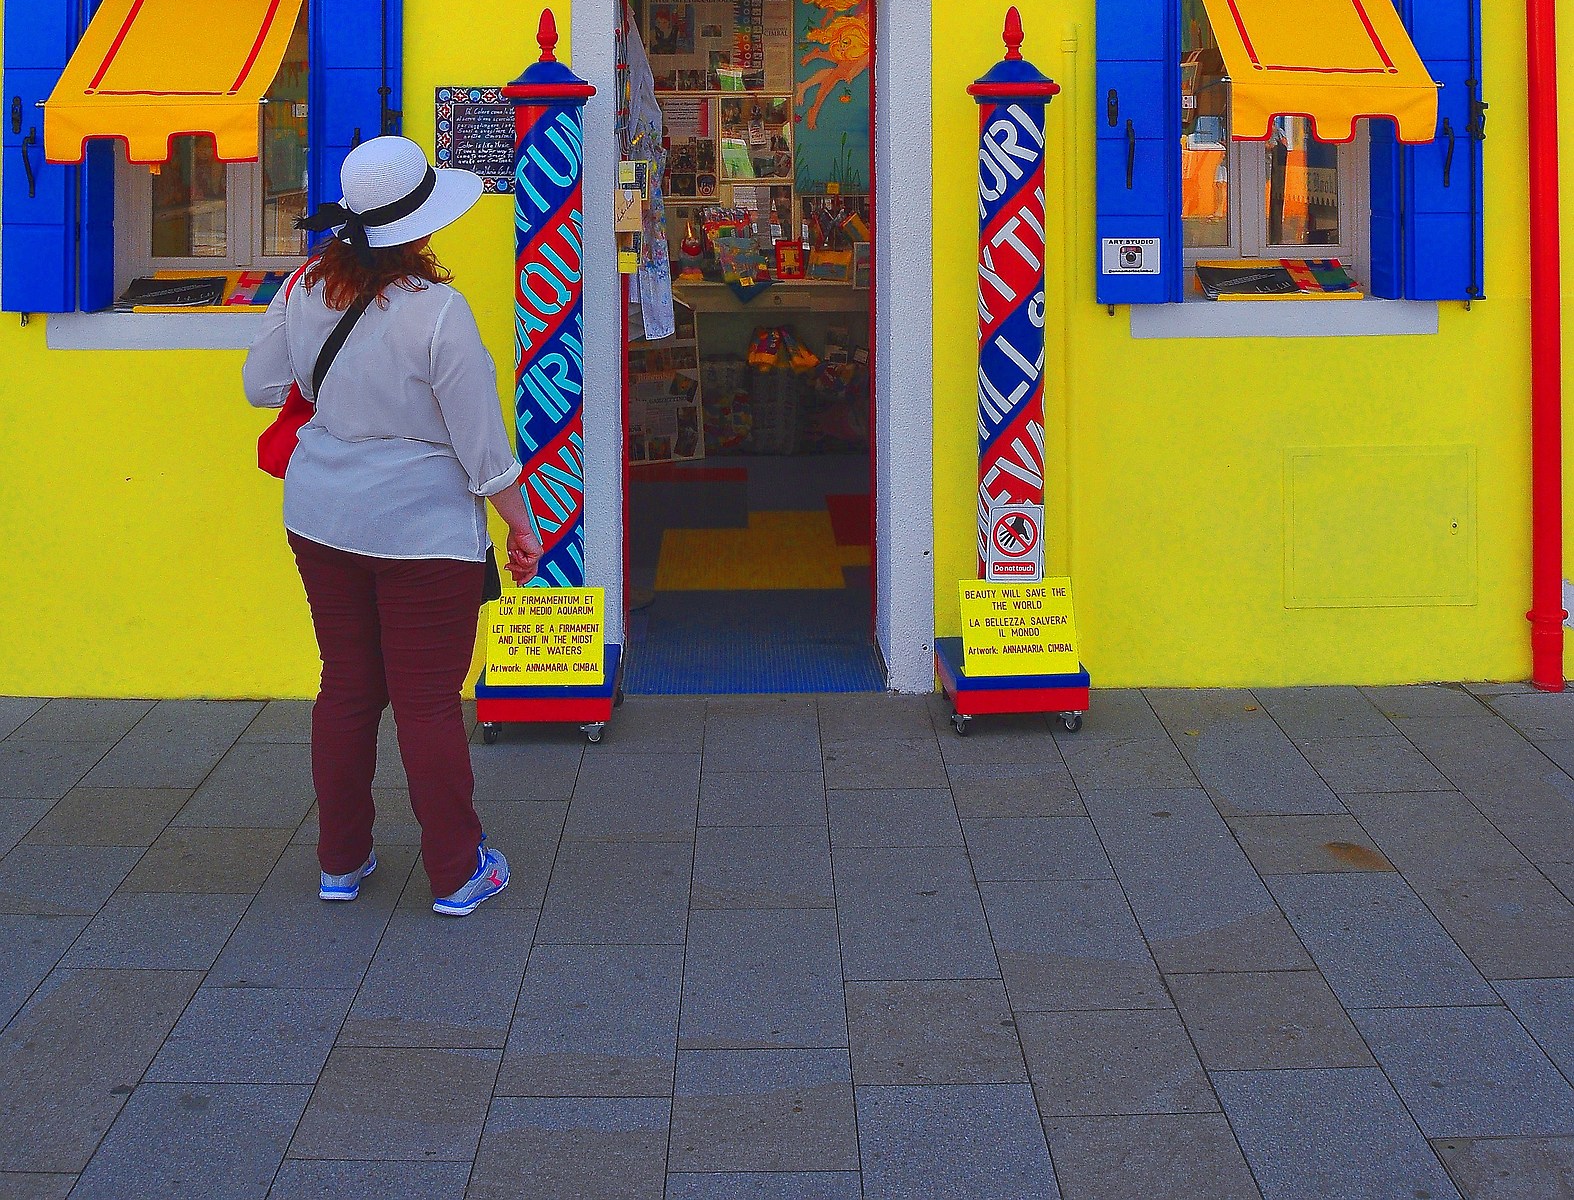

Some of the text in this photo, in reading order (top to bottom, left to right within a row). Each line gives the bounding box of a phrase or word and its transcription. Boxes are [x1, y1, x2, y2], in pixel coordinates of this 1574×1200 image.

[1016, 564, 1034, 572] touch
[965, 588, 1066, 599] BEAUTY WILL SAVE THE
[499, 596, 594, 605] FIAT FIRMAMENTUM ET
[992, 600, 1042, 610] THE WORLD
[499, 606, 594, 615] LUX IN MEDIO AQUARUM
[969, 615, 1068, 627] LA BELLEZZA SALVERA'
[492, 624, 599, 633] LET THERE BE A FIRMAMENT
[998, 627, 1040, 637] IL MONDO
[498, 635, 593, 644] AND LIGHT IN THE MIDST
[508, 646, 582, 656] OF THE WATERS
[968, 643, 1073, 655] Artwork: ANNAMARIA CIMBAL
[490, 663, 599, 673] Artwork: ANNAMARIA CIMBAL
